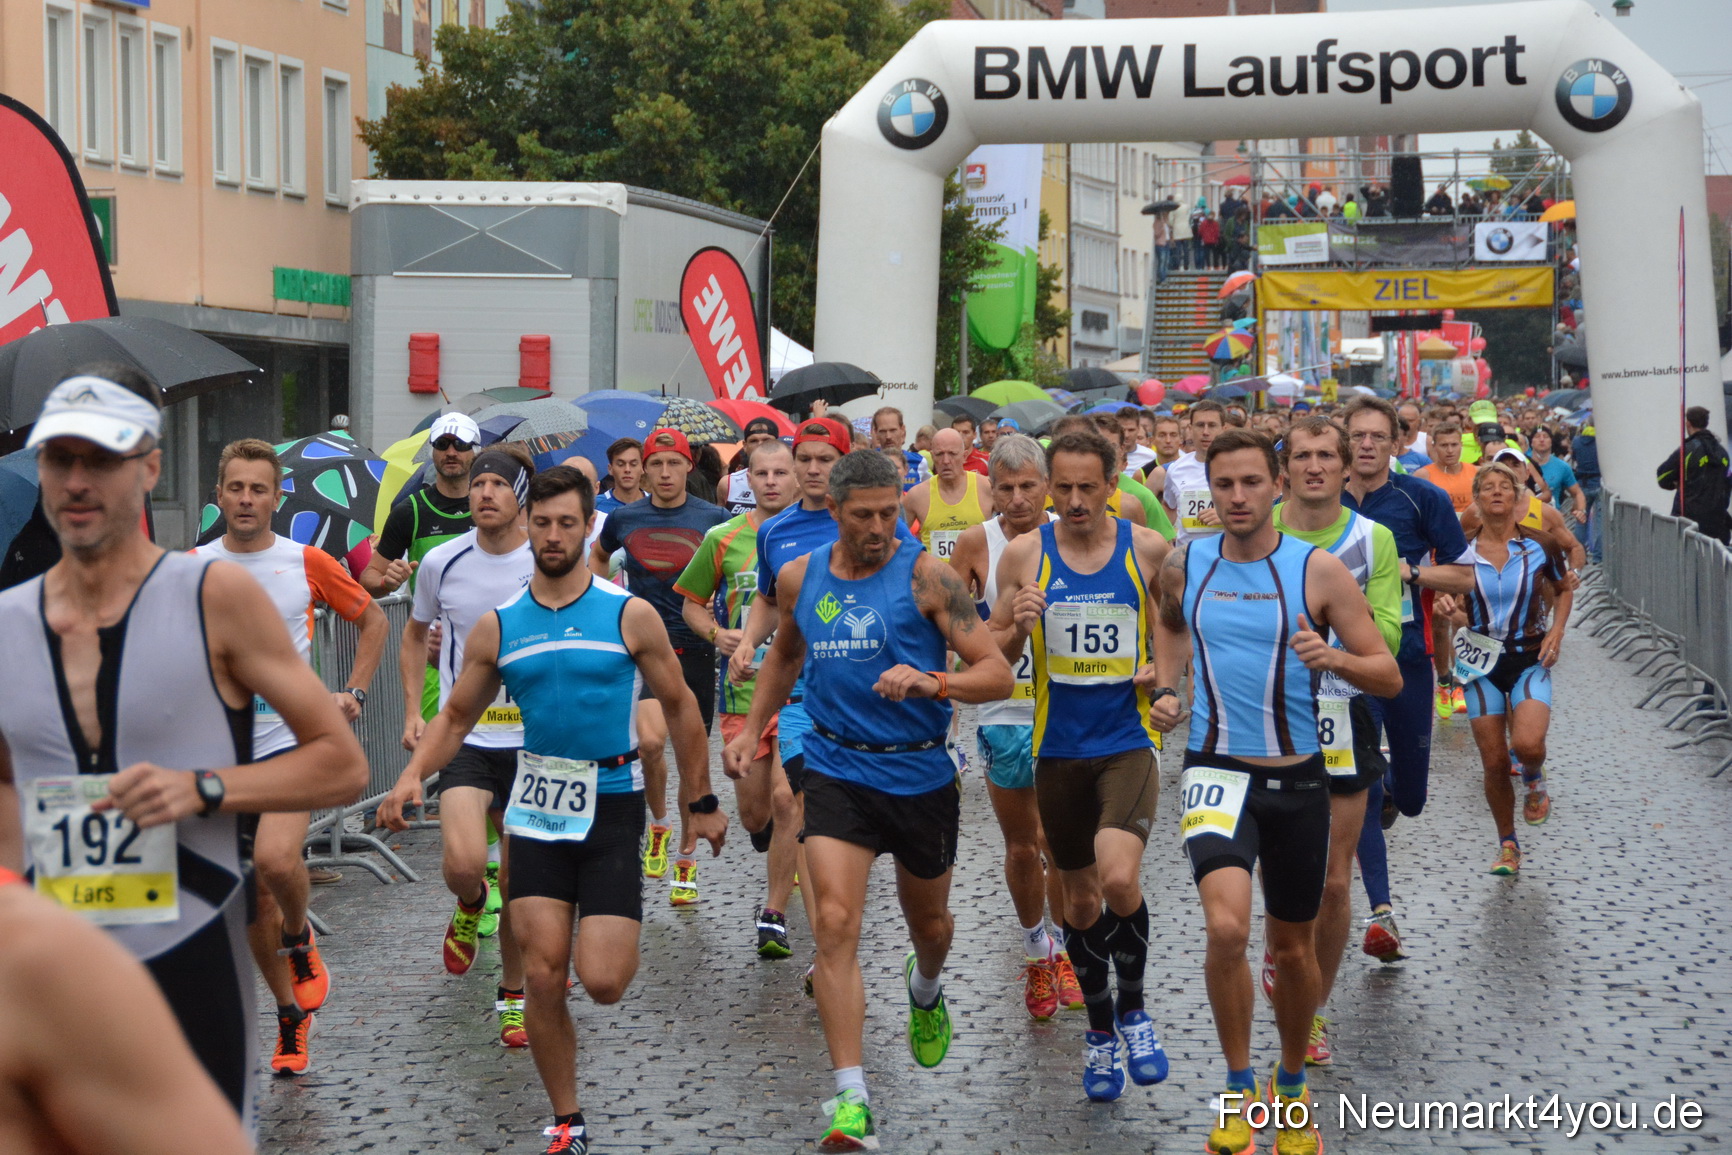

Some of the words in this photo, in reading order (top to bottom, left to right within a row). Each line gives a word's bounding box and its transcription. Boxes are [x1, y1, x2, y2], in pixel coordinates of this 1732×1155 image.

[974, 44, 1163, 100] BMW
[1184, 35, 1527, 105] Laufsport
[1563, 60, 1627, 84] BMW
[883, 80, 941, 105] BMW
[1375, 278, 1438, 300] ZIEL
[1073, 592, 1115, 601] INTERSPORT
[1086, 606, 1129, 617] BOCK
[813, 639, 879, 651] GRAMMER
[1065, 623, 1118, 653] 153
[813, 650, 848, 659] SOLAR
[1074, 661, 1107, 673] Mario
[519, 773, 587, 813] 2673
[527, 814, 567, 832] Roland
[53, 812, 142, 868] 192
[73, 883, 116, 903] Lars
